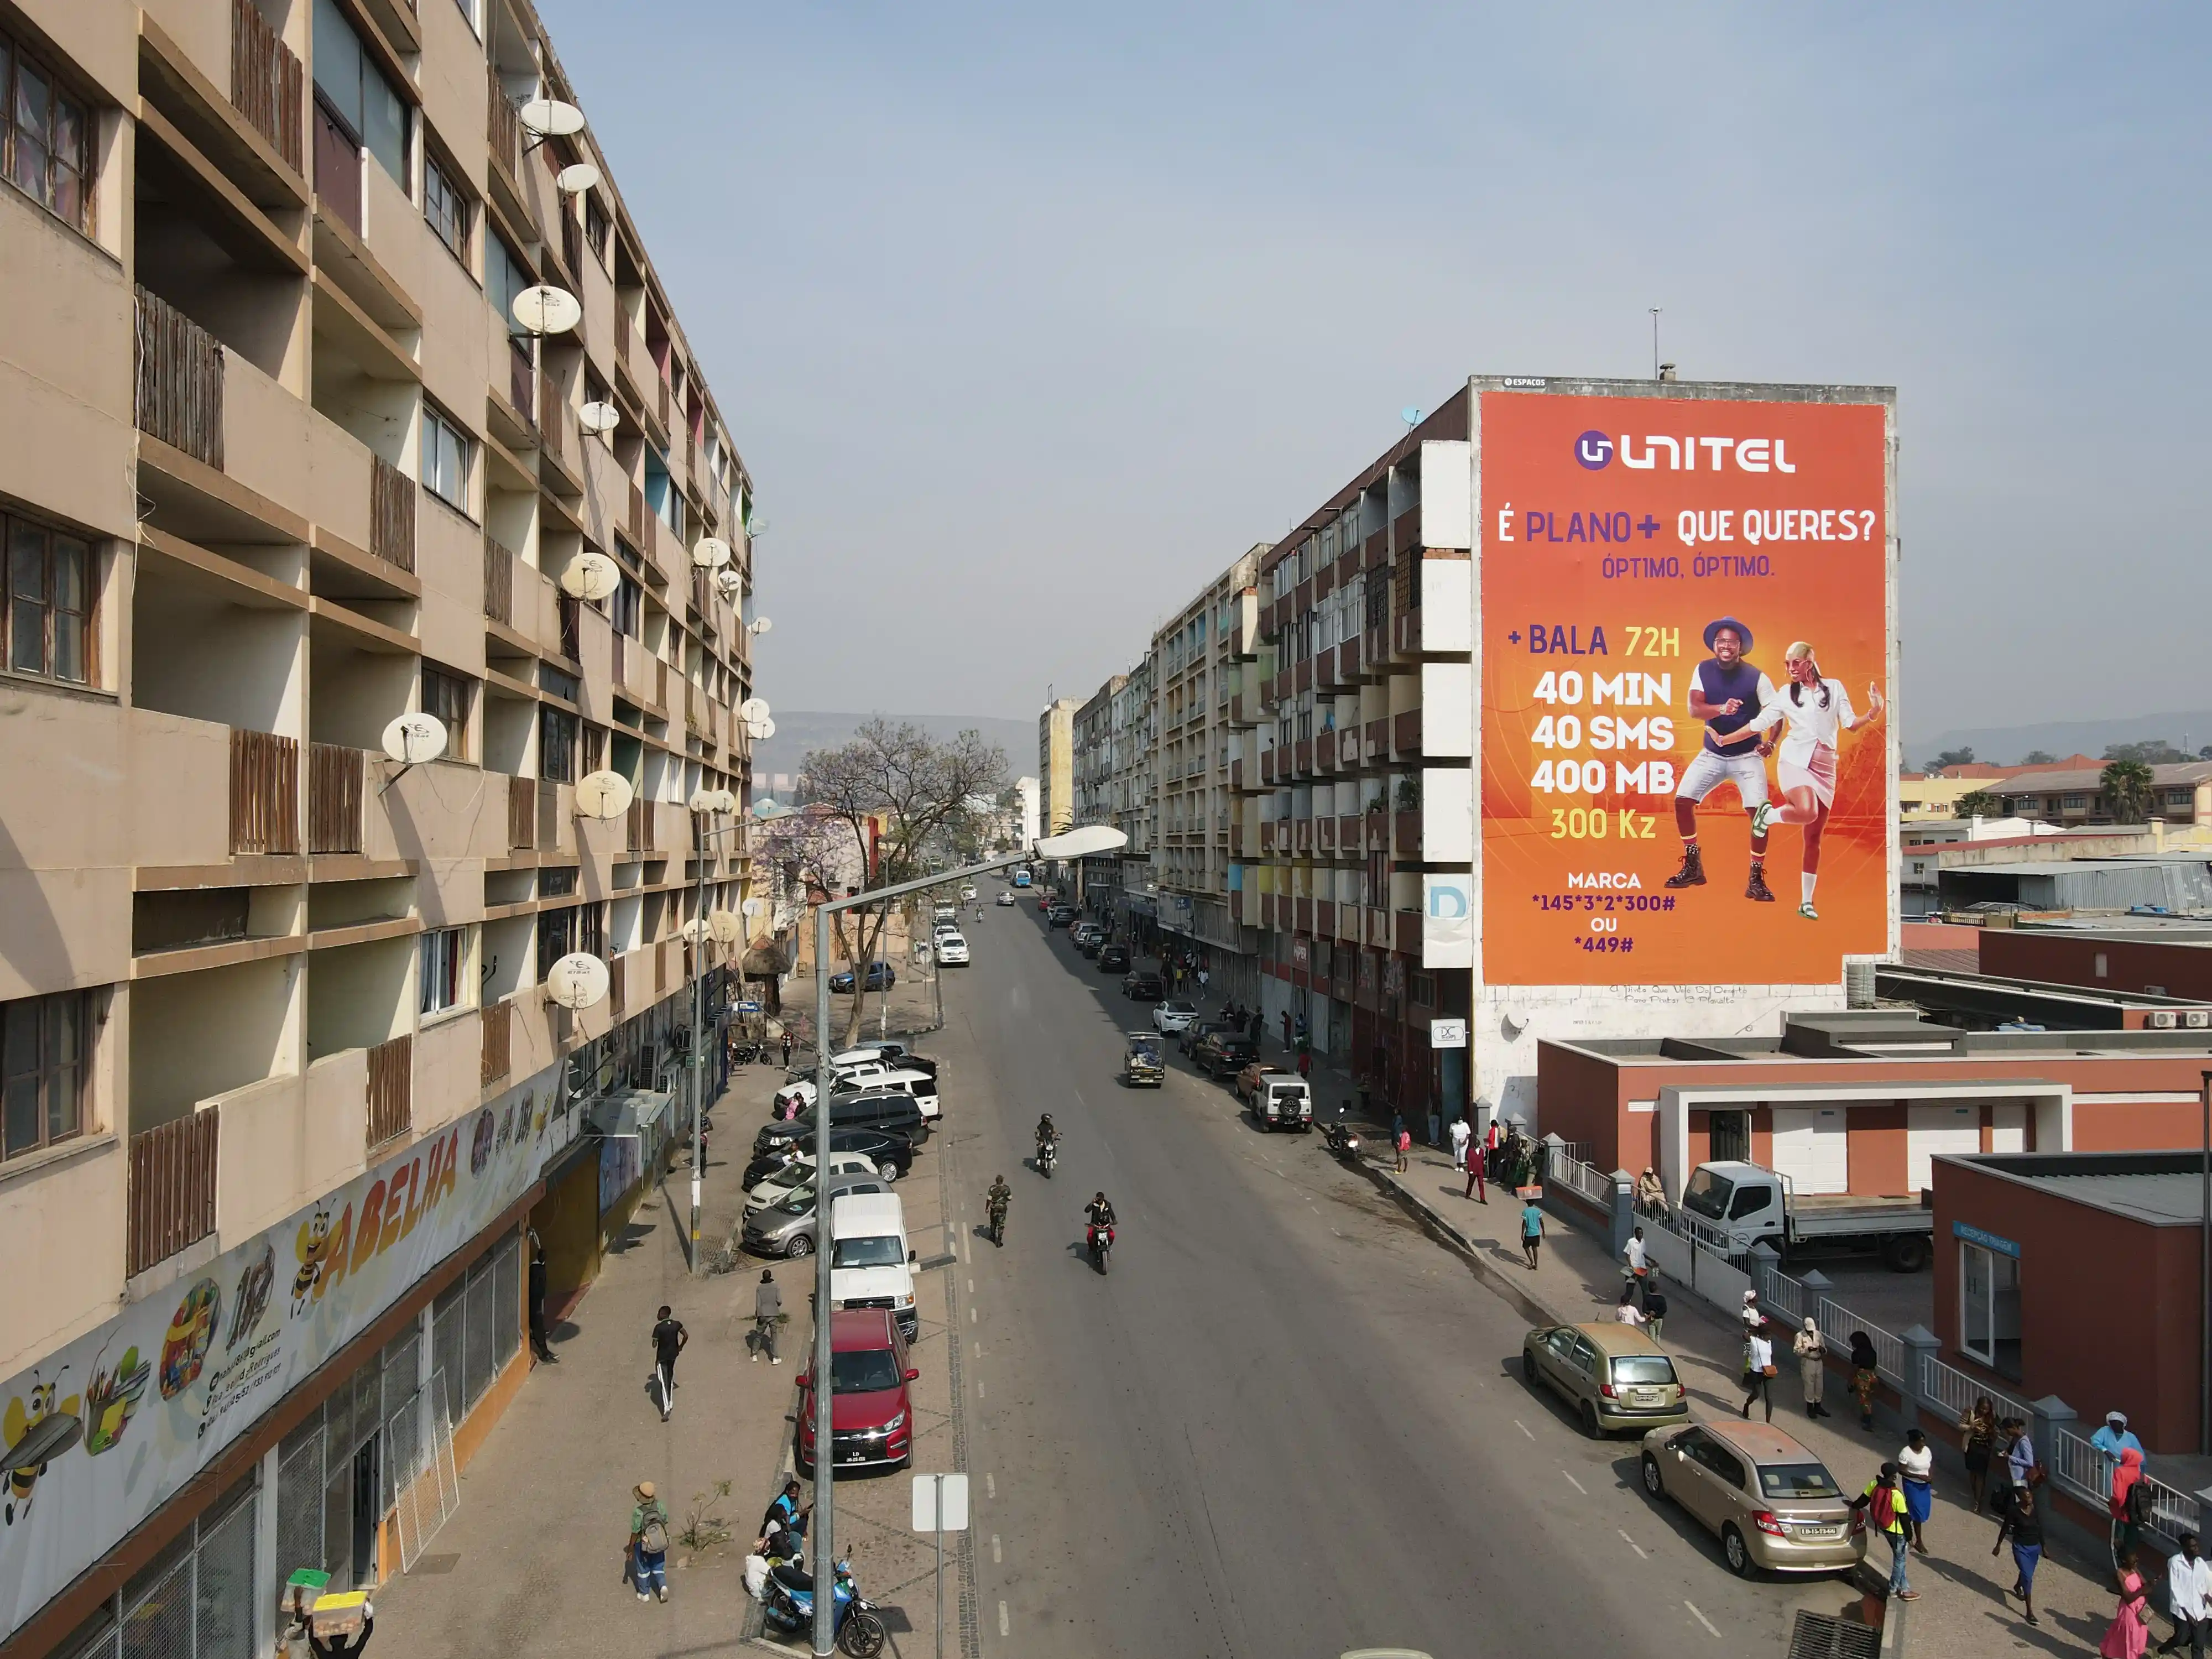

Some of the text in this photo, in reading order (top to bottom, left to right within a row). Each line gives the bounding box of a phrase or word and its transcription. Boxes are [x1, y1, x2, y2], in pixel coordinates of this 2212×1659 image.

[1513, 378, 1546, 387] ESPAÇOS
[1621, 435, 1796, 473] UNITEL
[1499, 502, 1514, 541] É
[1678, 510, 1734, 546] QUE
[1743, 509, 1876, 546] QUERES?
[1530, 624, 1608, 655] BALA
[1625, 626, 1679, 656] 72H
[1533, 670, 1671, 706] 40 MIN
[1531, 714, 1674, 751] 40 SMS
[1530, 759, 1675, 795] 400 MB
[1550, 808, 1656, 839] 300 Kz
[1568, 872, 1642, 889] MARCA
[1590, 917, 1618, 932] OU
[1652, 985, 1668, 994] Que
[311, 1127, 458, 1303] ABELHA
